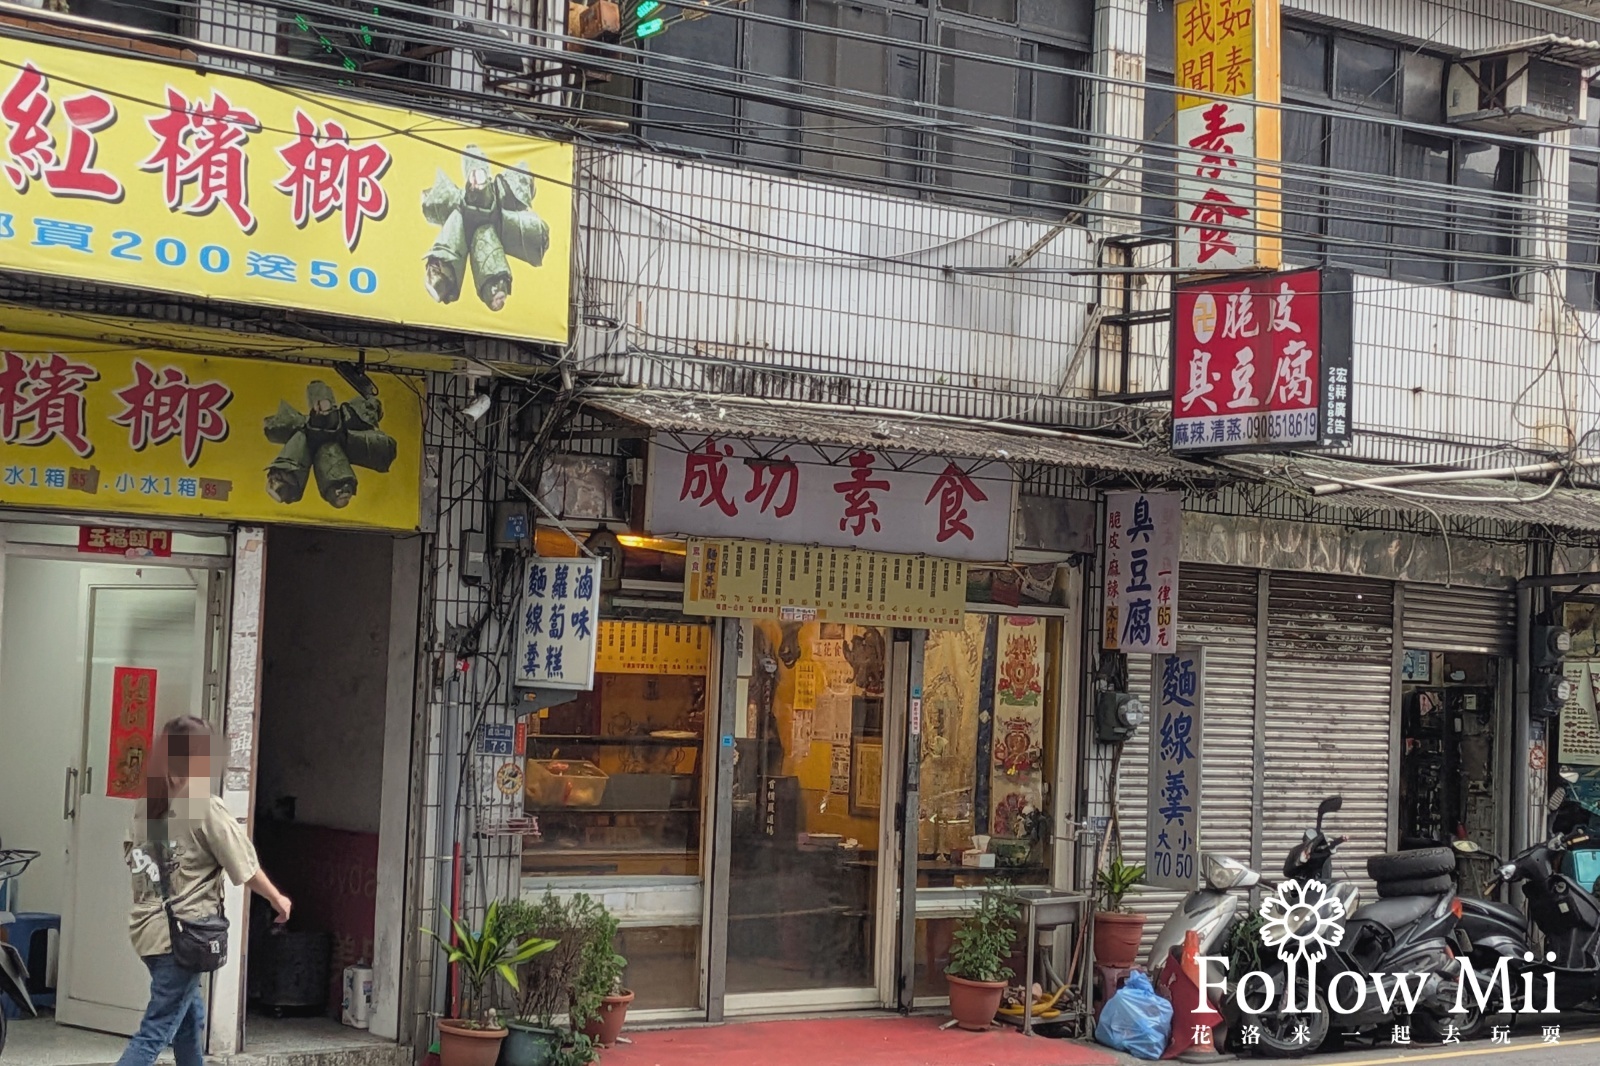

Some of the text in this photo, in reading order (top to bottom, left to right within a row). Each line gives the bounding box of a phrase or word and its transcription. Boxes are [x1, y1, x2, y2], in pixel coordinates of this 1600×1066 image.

[0, 63, 388, 248] 紅檳榔
[1185, 103, 1250, 264] 素食
[1221, 282, 1301, 339] 脆皮
[0, 351, 228, 462] 檳榔
[1181, 340, 1313, 413] 臭豆腐
[87, 527, 168, 550] 五福臨門
[679, 437, 989, 543] 成功素食
[522, 564, 547, 678] 麵線羹
[571, 566, 593, 640] 滷味
[1121, 495, 1155, 646] 臭豆腐
[490, 741, 507, 753] 73
[1159, 654, 1197, 826] 麵線羹
[1155, 851, 1193, 879] 70 50
